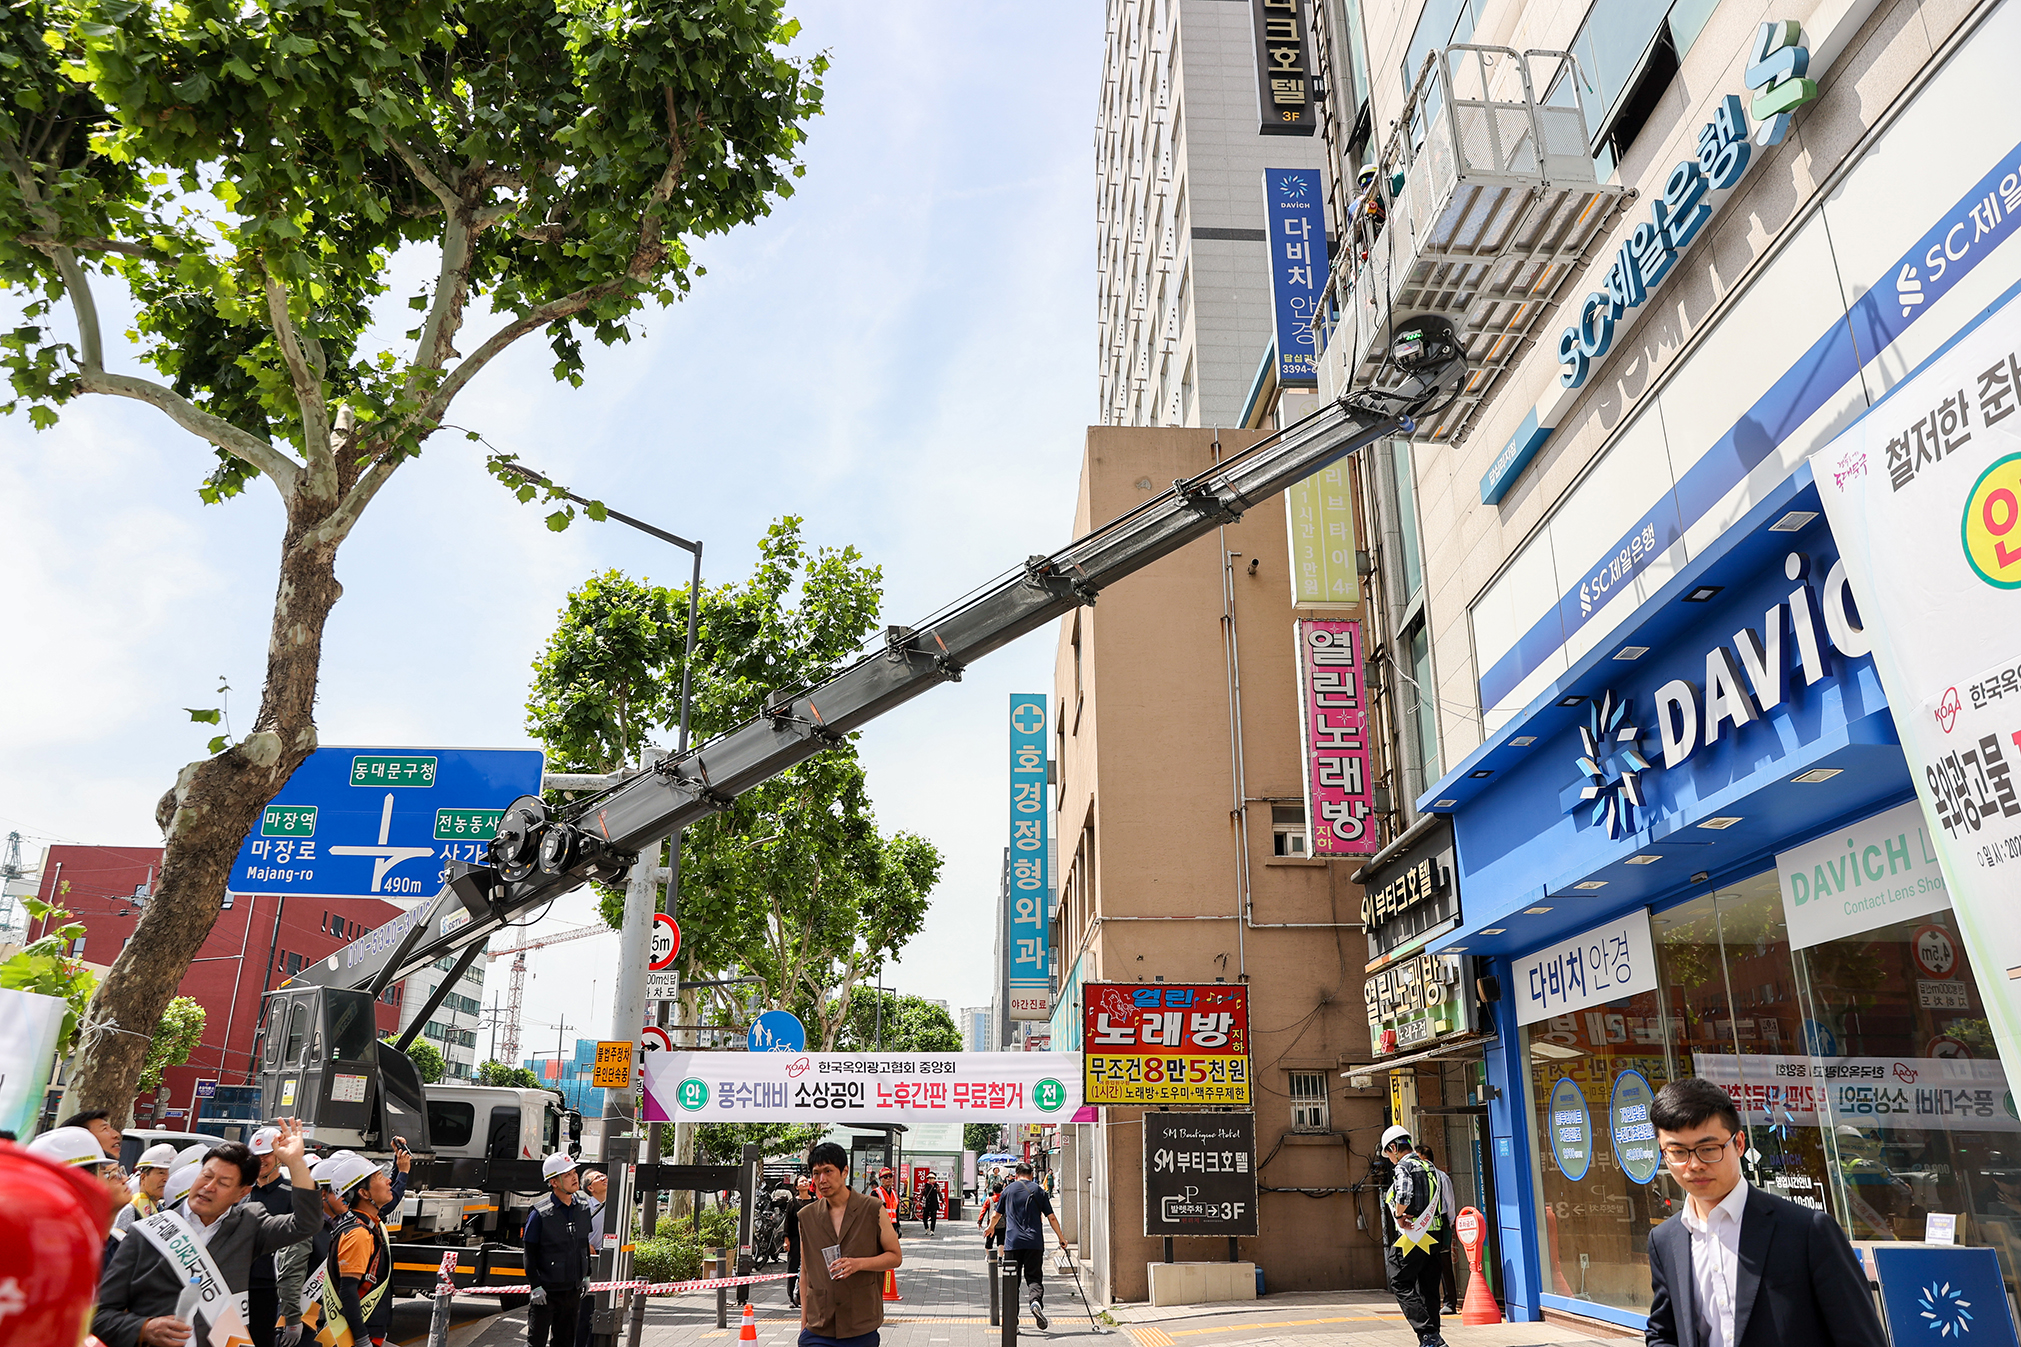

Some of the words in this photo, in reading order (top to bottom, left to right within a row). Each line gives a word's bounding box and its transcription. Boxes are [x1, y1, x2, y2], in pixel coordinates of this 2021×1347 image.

[1282, 111, 1300, 122] 3F
[1284, 217, 1313, 290] 다비치
[1557, 94, 1751, 389] SC제일은행
[1290, 295, 1317, 345] 안경
[1284, 354, 1316, 363] 답십리
[1886, 389, 1971, 492] 철저한
[1977, 351, 2021, 428] 준
[1591, 522, 1656, 601] SC제일은행
[1332, 578, 1354, 595] 4F
[1307, 630, 1373, 841] 열린노래방
[353, 762, 435, 782] 동대문구청
[265, 812, 315, 831] 마장역
[438, 814, 500, 834] 전농동사
[1316, 826, 1334, 851] 지하
[251, 840, 316, 864] 마장로
[1013, 744, 1046, 970] 호경정형외과
[246, 866, 314, 883] Majang-ro
[1790, 837, 1919, 907] DAViCH
[383, 876, 422, 894] 490m
[1375, 857, 1432, 925] 부티크호텔
[1843, 889, 1886, 916] Contact
[1888, 882, 1916, 903] Lens
[1529, 946, 1587, 1009] 다비치
[1589, 930, 1632, 991] 안경
[1131, 989, 1195, 1009] 열린
[1363, 955, 1444, 1027] 열린노래방
[1011, 999, 1047, 1010] 야간진료
[1094, 1012, 1236, 1048] 노래방
[1231, 1028, 1245, 1054] 지하
[597, 1046, 631, 1063] 불법주정차
[594, 1066, 628, 1083] 무인단속중
[818, 1061, 915, 1074] 한국옥외광고협회
[919, 1061, 956, 1074] 중앙회
[686, 1082, 701, 1106] 안
[718, 1081, 788, 1109] 풍수대비
[794, 1081, 865, 1109] 소상공인
[876, 1081, 947, 1109] 노후간판
[953, 1081, 1023, 1109] 무료철거
[1042, 1083, 1057, 1107] 전
[1091, 1085, 1123, 1099] (1시간)
[1180, 1128, 1216, 1146] Boutique
[1218, 1128, 1240, 1139] Hotel
[1177, 1150, 1249, 1174] 부티크호텔
[1220, 1202, 1246, 1220] 3F
[169, 1234, 200, 1266] 안전
